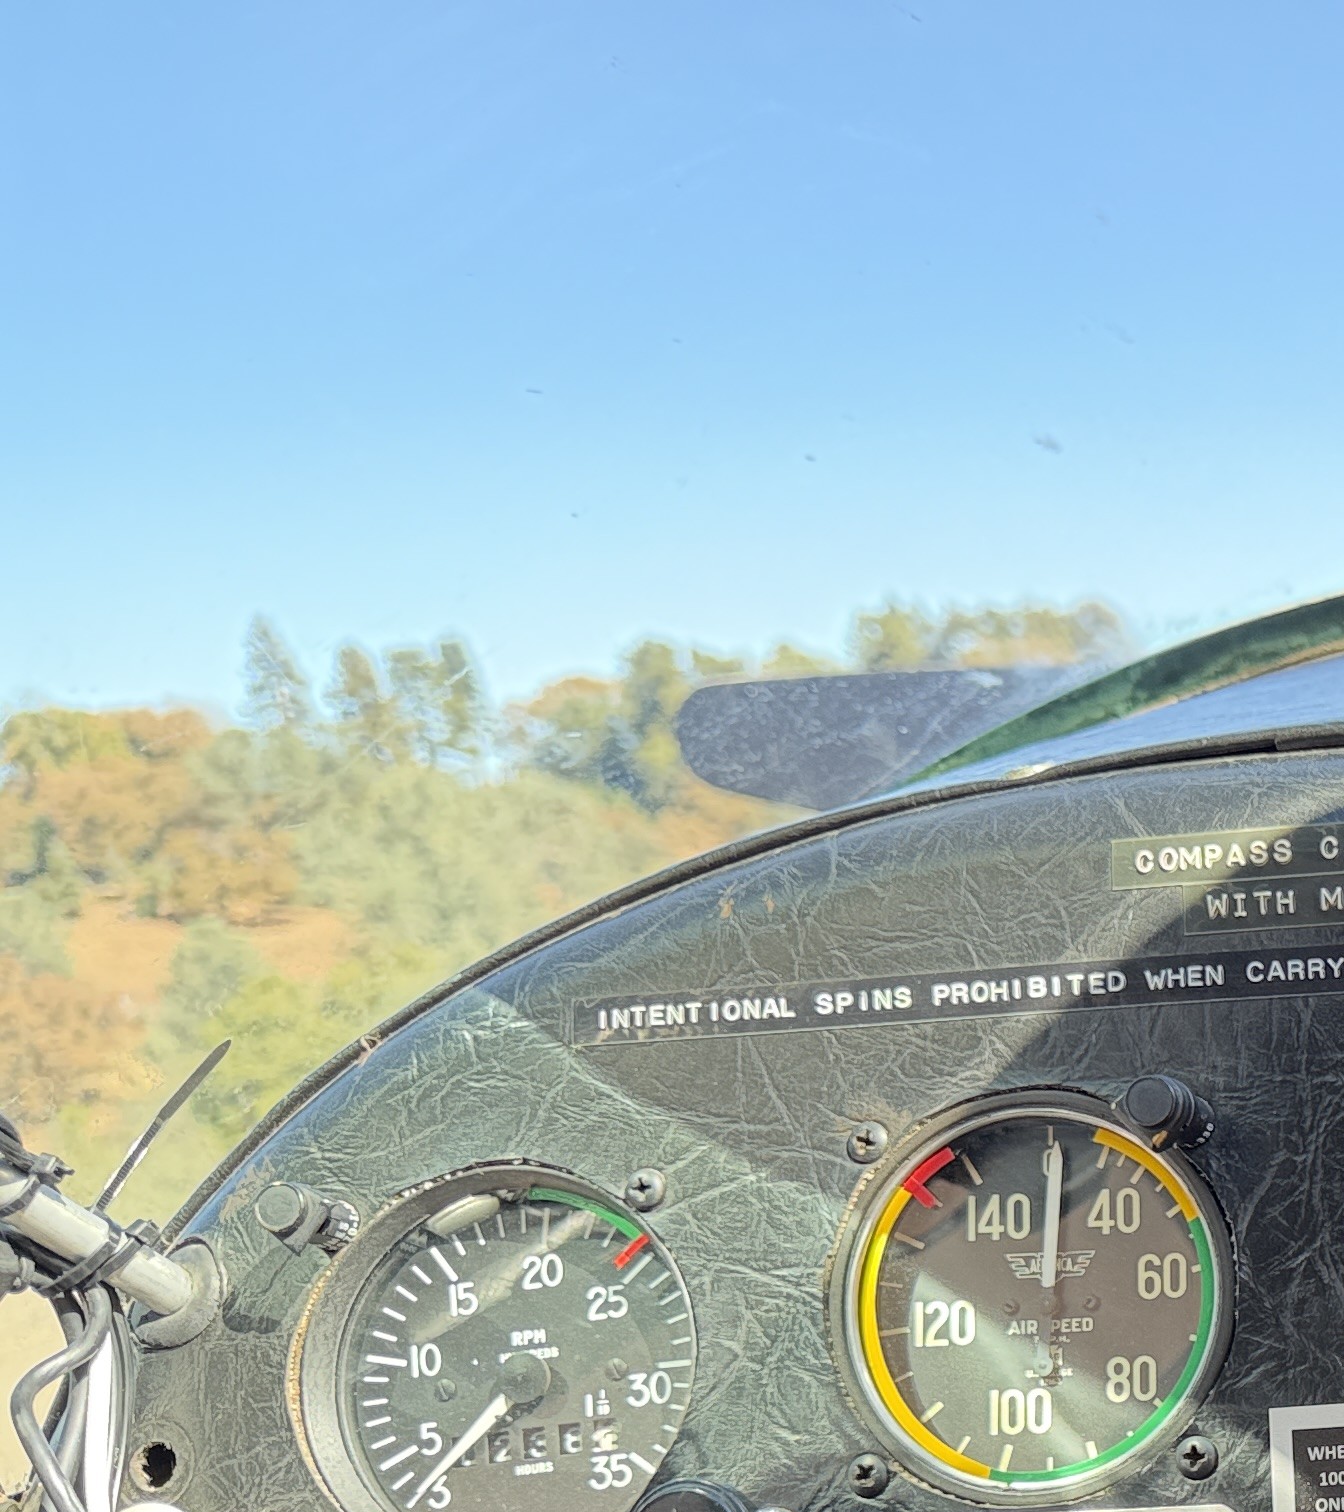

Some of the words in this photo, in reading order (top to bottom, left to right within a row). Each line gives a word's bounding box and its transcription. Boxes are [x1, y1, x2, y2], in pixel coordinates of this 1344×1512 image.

[1135, 838, 1293, 874] COMPASS
[1206, 889, 1297, 919] WITH
[597, 997, 795, 1031] INTENTIONAL
[814, 986, 913, 1016] SPINS
[931, 971, 1126, 1007] PROHIBITED
[1143, 964, 1225, 992] WHEN
[967, 1192, 1031, 1242] 140
[1087, 1187, 1141, 1236] 40
[521, 1254, 564, 1290] 20
[1136, 1253, 1187, 1299] 60
[449, 1283, 478, 1316] 15
[586, 1286, 628, 1321] 25
[912, 1300, 977, 1348] 120
[1008, 1319, 1038, 1335] AIR
[410, 1344, 442, 1378] 10
[1105, 1354, 1157, 1403] 80
[626, 1371, 672, 1407] 30
[988, 1387, 1052, 1436] 100
[514, 1461, 554, 1476] HOURS
[588, 1453, 633, 1490] 35
